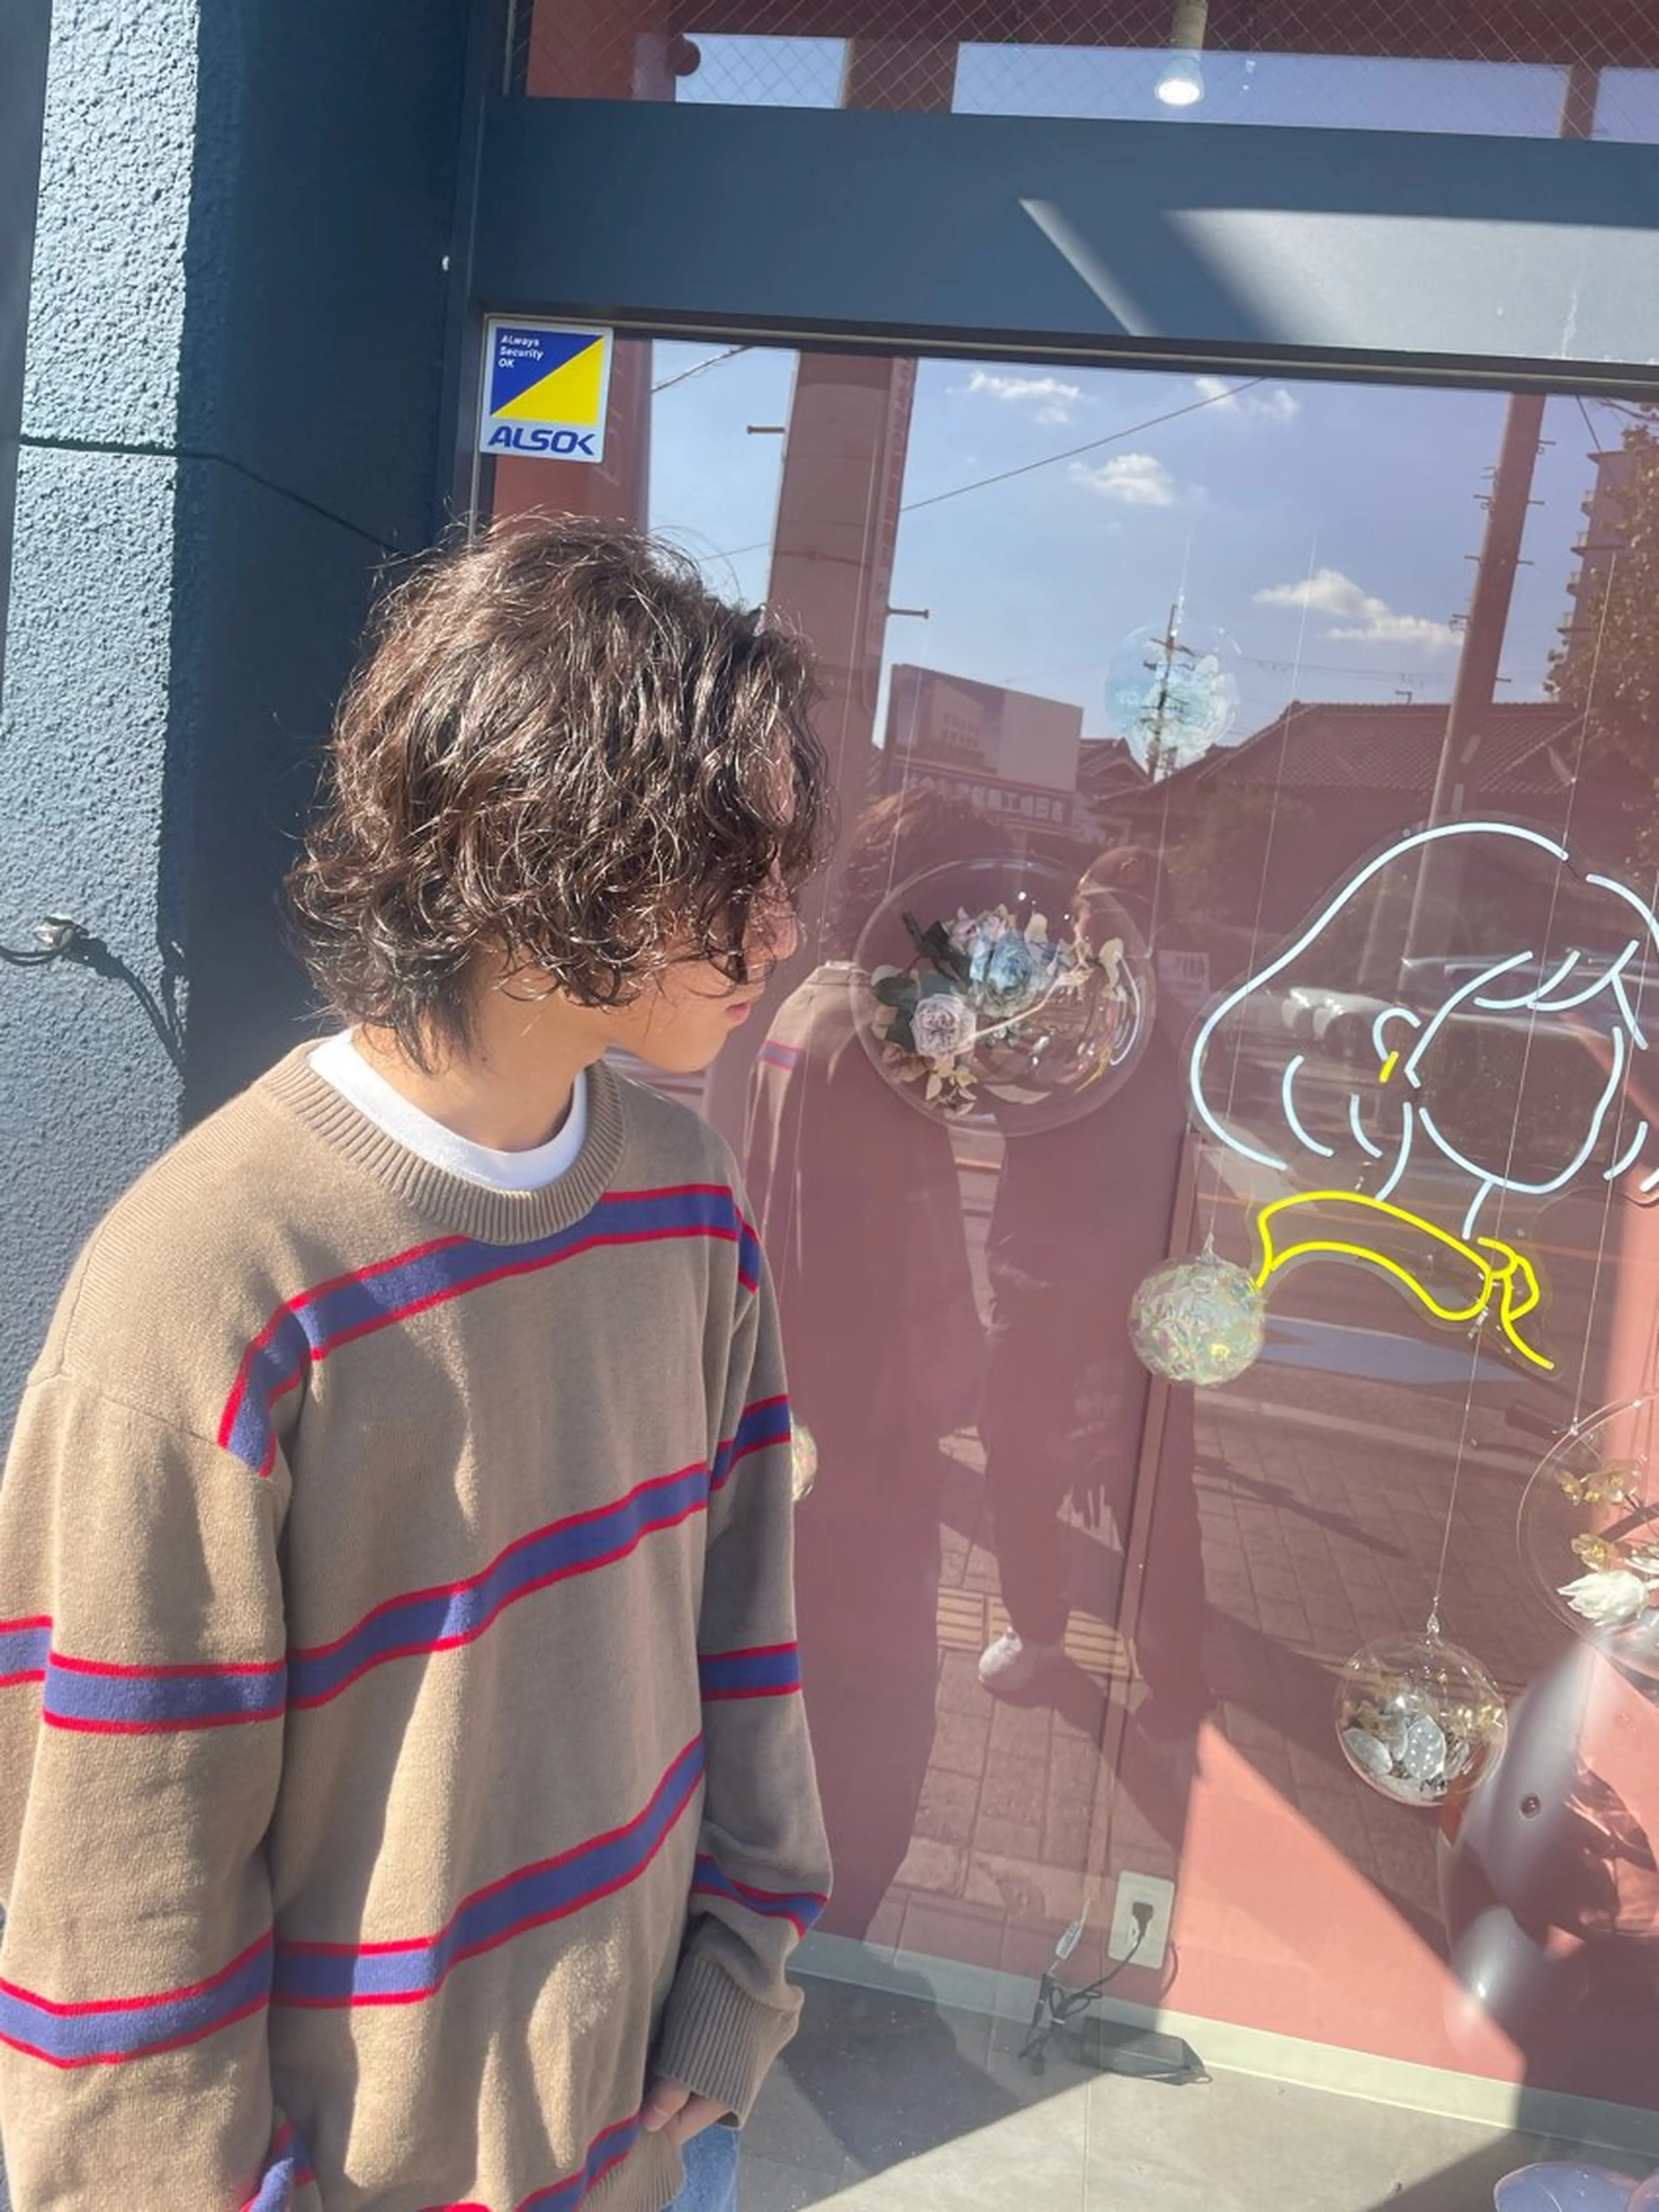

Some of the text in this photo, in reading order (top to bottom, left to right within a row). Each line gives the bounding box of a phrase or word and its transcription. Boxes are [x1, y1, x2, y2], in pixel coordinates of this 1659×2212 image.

[500, 346, 543, 361] Security
[498, 358, 515, 368] OK
[488, 426, 595, 456] ALSOK
